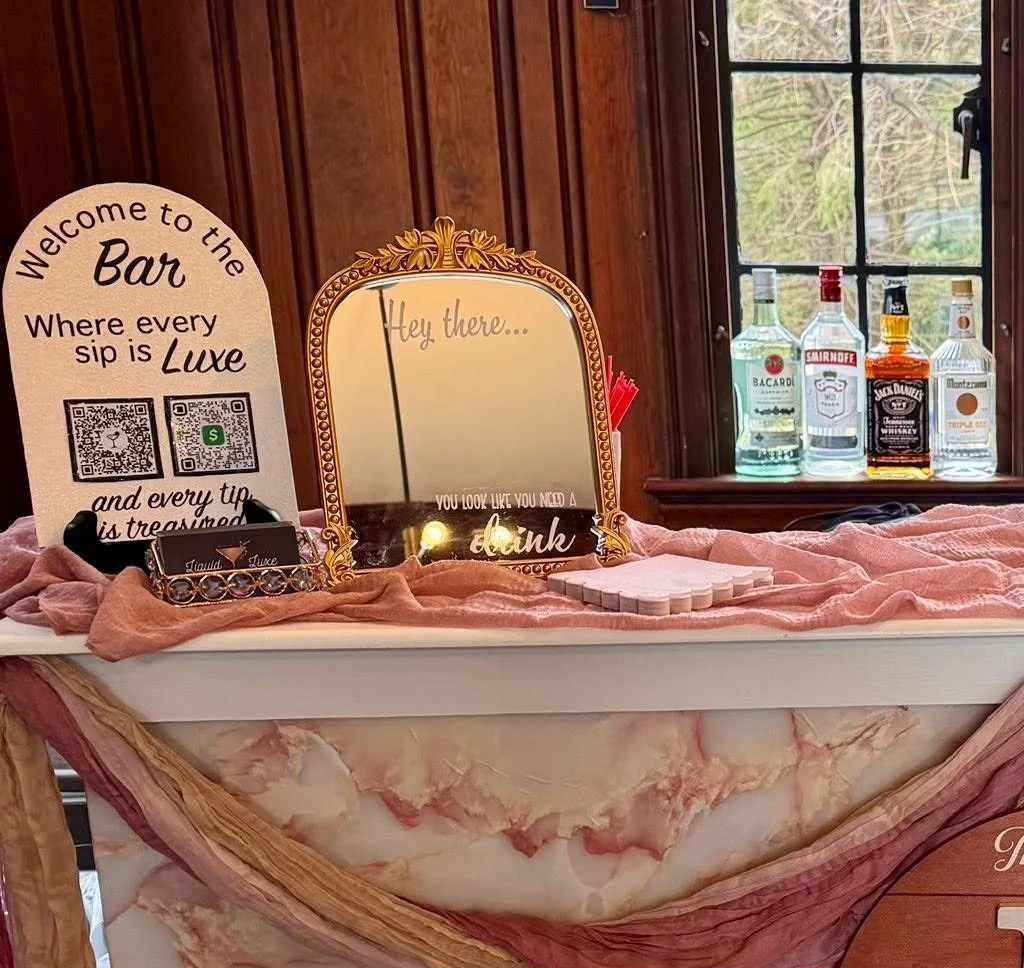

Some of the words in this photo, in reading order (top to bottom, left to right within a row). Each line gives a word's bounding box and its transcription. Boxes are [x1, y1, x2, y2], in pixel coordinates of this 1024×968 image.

[16, 200, 148, 283] Welcome
[160, 202, 194, 234] to
[201, 226, 246, 279] the
[93, 238, 187, 289] Bar
[24, 314, 125, 339] Where
[136, 313, 219, 337] every
[385, 298, 436, 351] Hey
[443, 298, 529, 339] there...
[75, 340, 118, 369] sip
[129, 339, 152, 363] is
[161, 337, 247, 373] Luxe
[874, 385, 895, 402] JACK
[893, 382, 923, 402] DANIEL'S
[91, 485, 143, 513] and
[149, 485, 214, 518] every
[220, 482, 253, 511] tip
[435, 493, 458, 511] YOU
[462, 493, 488, 510] LOOK
[491, 492, 512, 510] LIKE
[514, 491, 537, 509] YOU
[540, 491, 565, 508] NEED
[569, 491, 577, 508] A
[98, 521, 121, 541] is
[248, 553, 278, 568] Luxe
